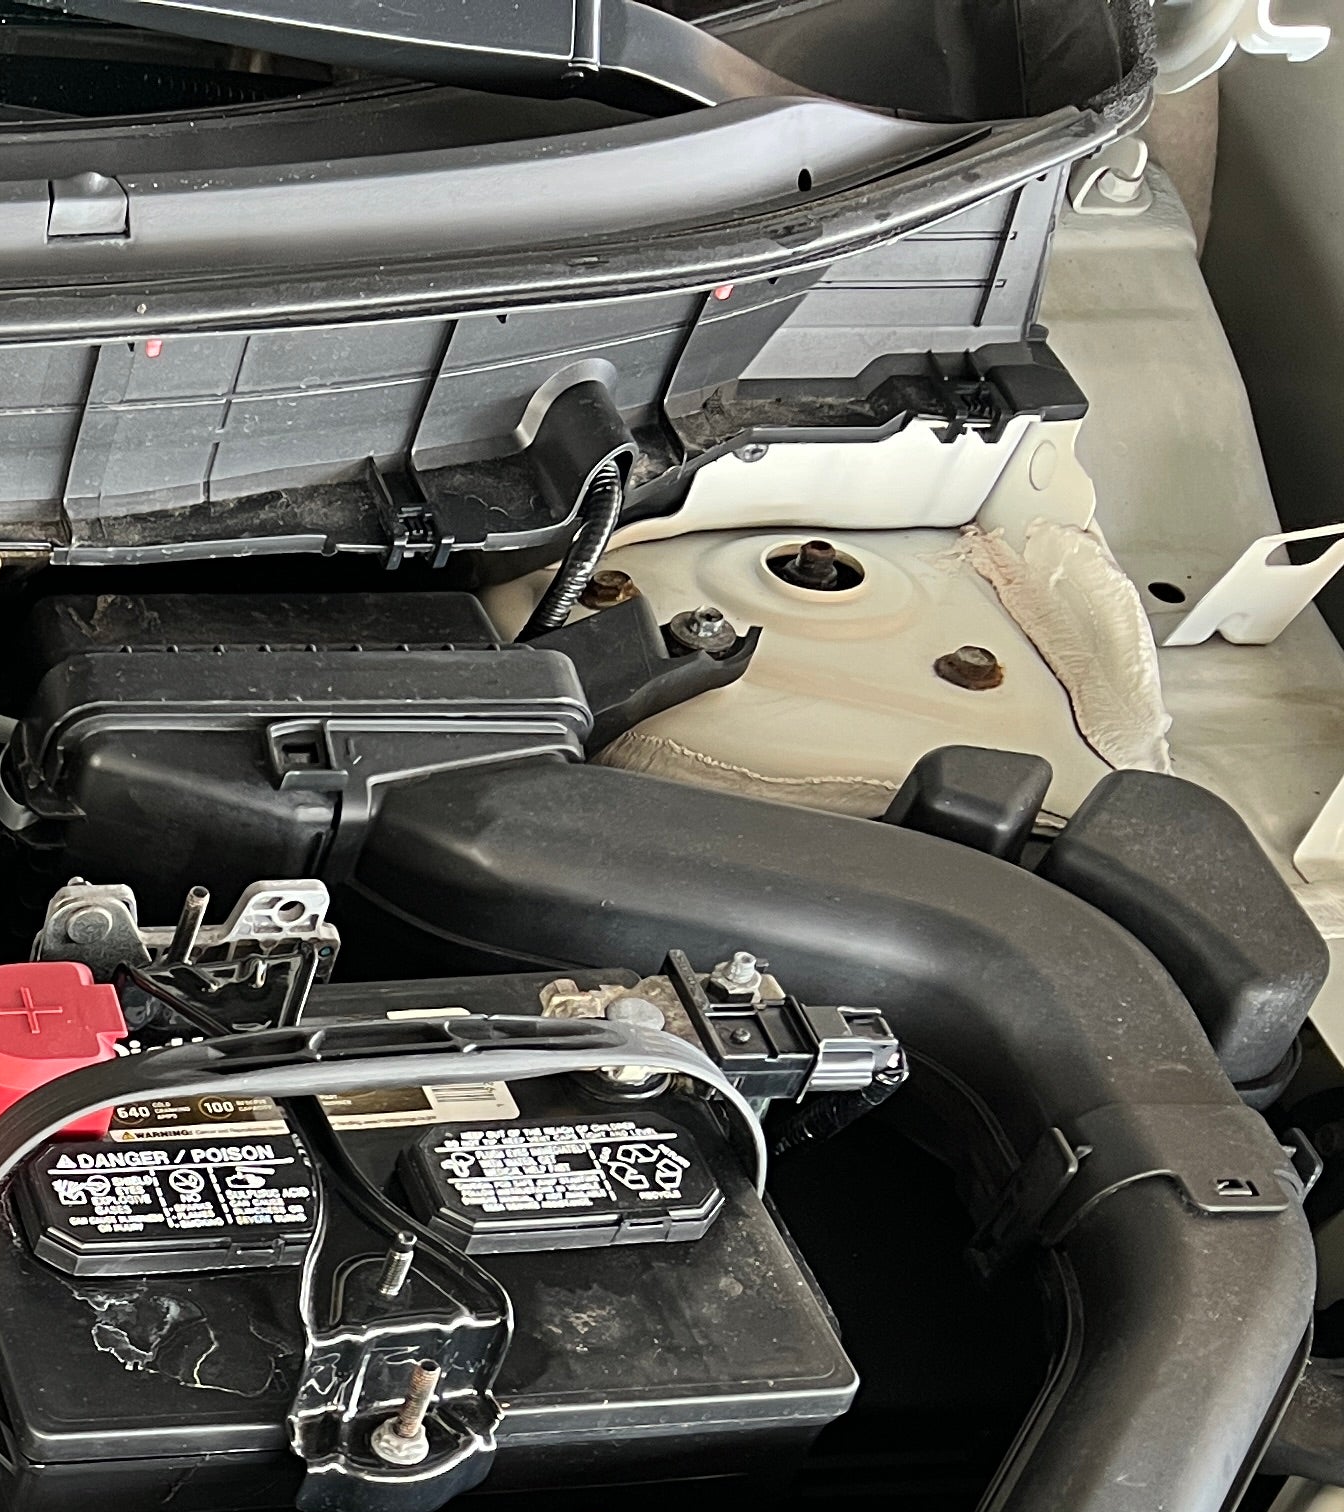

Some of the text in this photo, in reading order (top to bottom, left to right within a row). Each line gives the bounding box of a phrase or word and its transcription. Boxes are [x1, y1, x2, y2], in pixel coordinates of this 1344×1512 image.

[203, 1101, 234, 1114] 100
[77, 1151, 170, 1169] DANGER
[174, 1149, 186, 1164] /
[191, 1145, 275, 1163] POISON
[180, 1193, 202, 1203] NO
